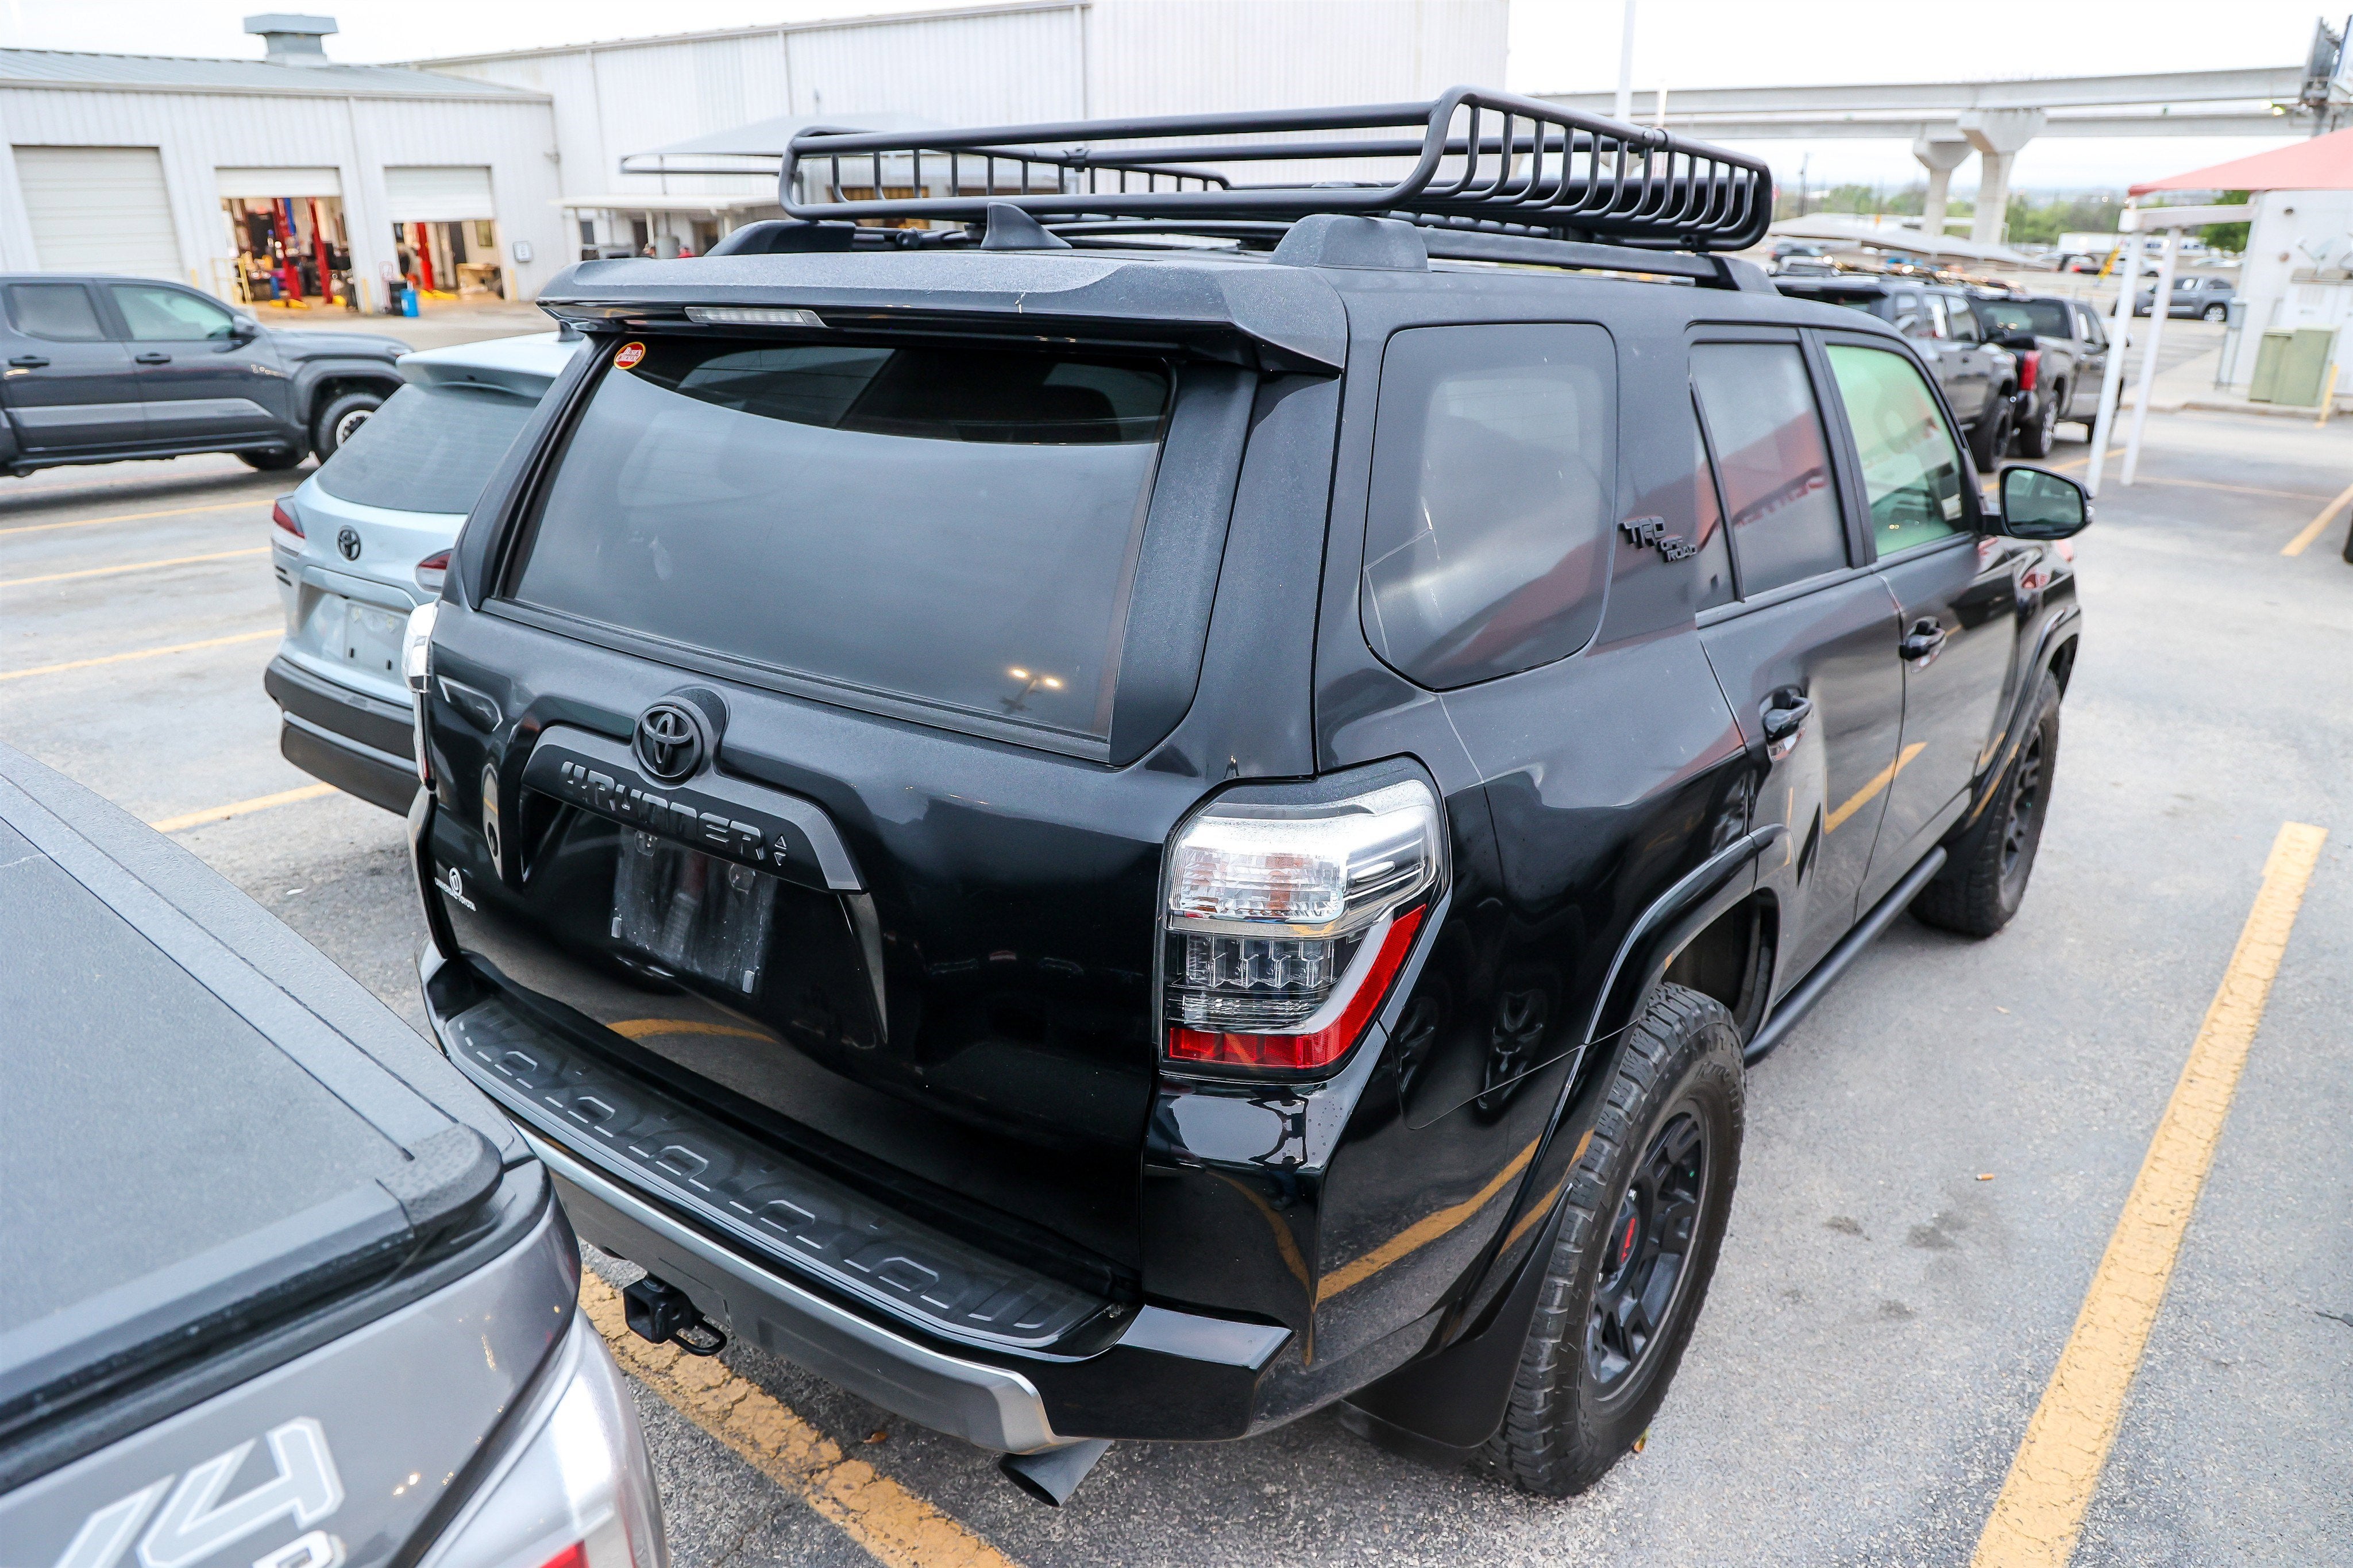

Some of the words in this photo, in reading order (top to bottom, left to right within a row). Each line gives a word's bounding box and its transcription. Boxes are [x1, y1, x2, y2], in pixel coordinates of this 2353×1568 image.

[1620, 516, 1666, 549] TRD
[1658, 535, 1683, 551] OFF
[1666, 544, 1698, 562] ROAD
[561, 761, 764, 860] 4RUNNER
[458, 895, 477, 912] TOYOTA
